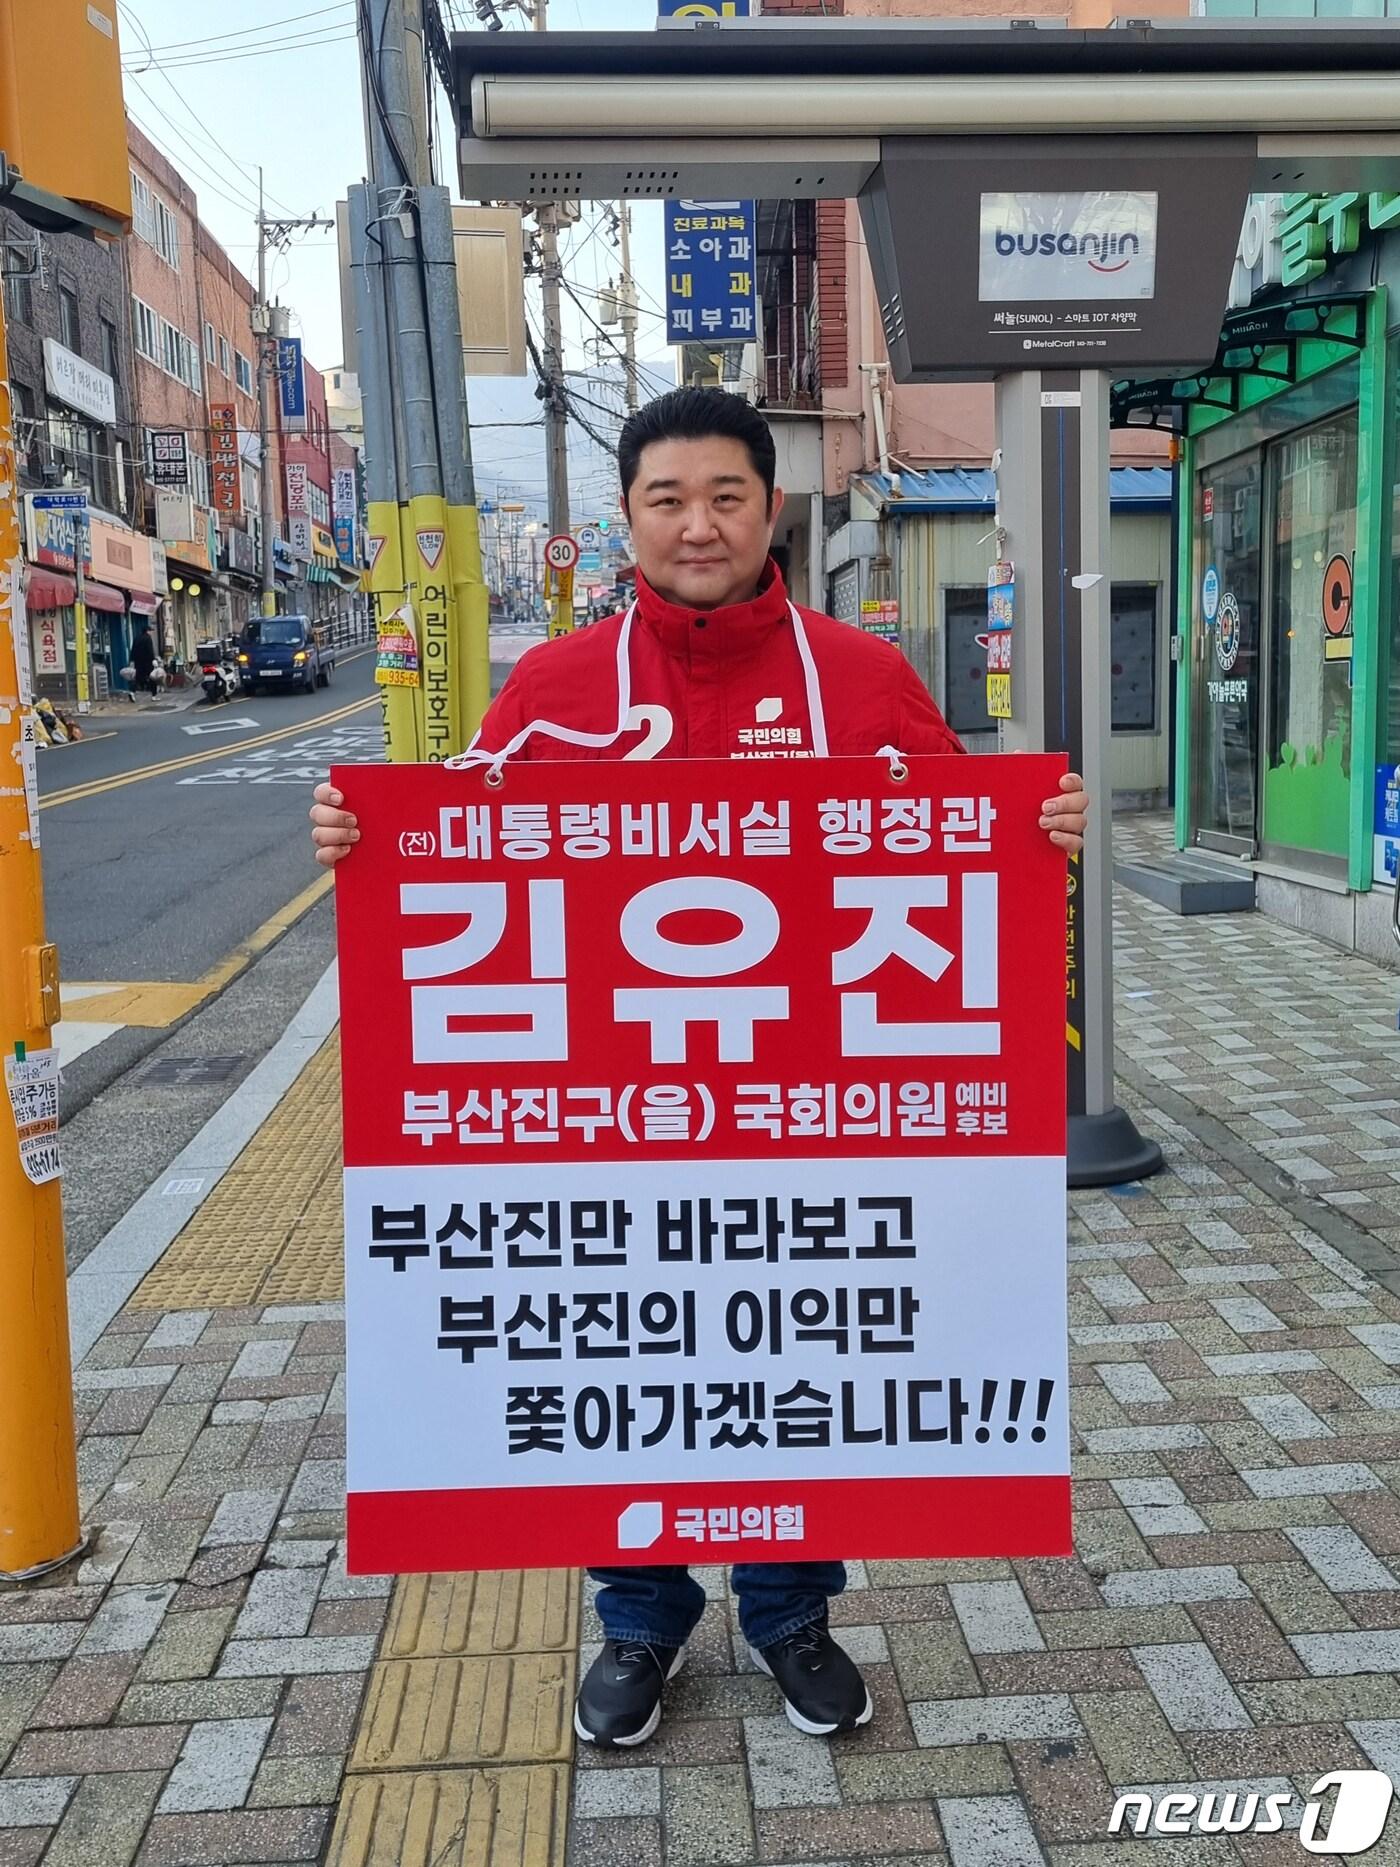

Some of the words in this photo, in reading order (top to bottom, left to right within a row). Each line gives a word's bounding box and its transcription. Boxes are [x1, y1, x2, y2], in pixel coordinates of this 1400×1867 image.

[673, 216, 746, 232] 진료과목
[995, 224, 1140, 263] busanjin
[1064, 313, 1090, 323] 스마트
[1111, 311, 1138, 323] 차양막
[1032, 339, 1075, 348] MetalCraft
[213, 433, 238, 508] 김밥천국
[48, 514, 91, 557] 대성식점
[552, 545, 571, 560] 30
[738, 728, 801, 745] 국민의힘
[817, 796, 998, 855] 행정관
[400, 872, 1001, 1064] 김유진
[402, 1083, 716, 1146] 부산진구(을)
[734, 1080, 946, 1139] 국회의원
[955, 1081, 1008, 1107] 예비
[955, 1110, 1009, 1136] 후보
[368, 1198, 633, 1272] 부산진만
[656, 1196, 917, 1264] 바라보고
[437, 1290, 697, 1364] 부산진의
[725, 1285, 921, 1356] 이익만
[505, 1378, 1056, 1456] 쫓아가겠습니다!!!
[674, 1504, 805, 1543] 국민의힘
